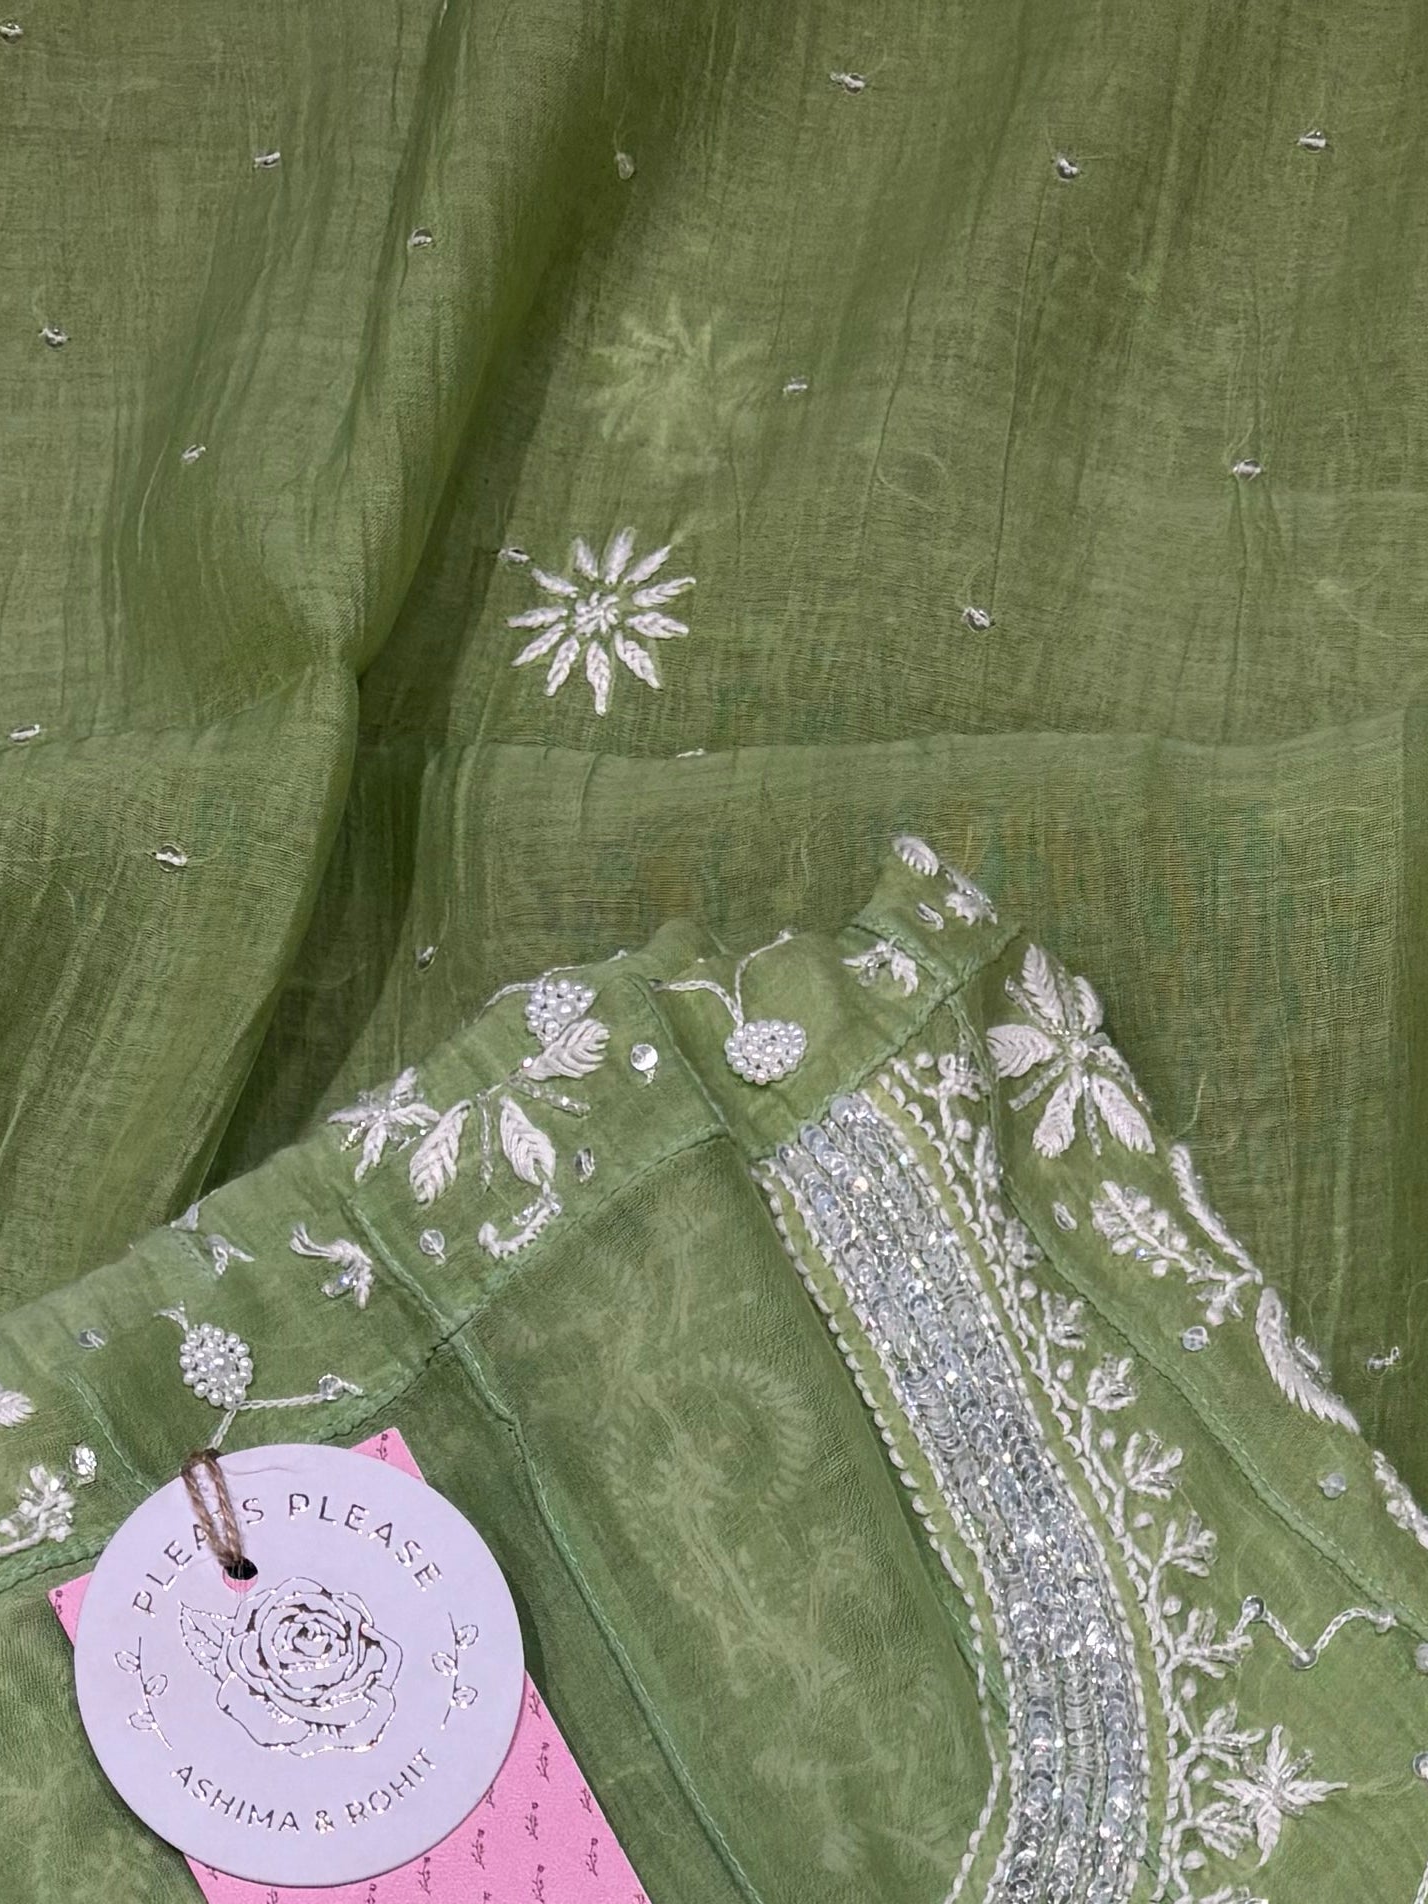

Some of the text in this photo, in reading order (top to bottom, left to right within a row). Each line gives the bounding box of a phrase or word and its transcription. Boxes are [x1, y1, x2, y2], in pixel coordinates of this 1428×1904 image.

[132, 1492, 443, 1618] PLEAS PLEASE
[170, 1747, 437, 1835] ASHIMA & ROHIT
